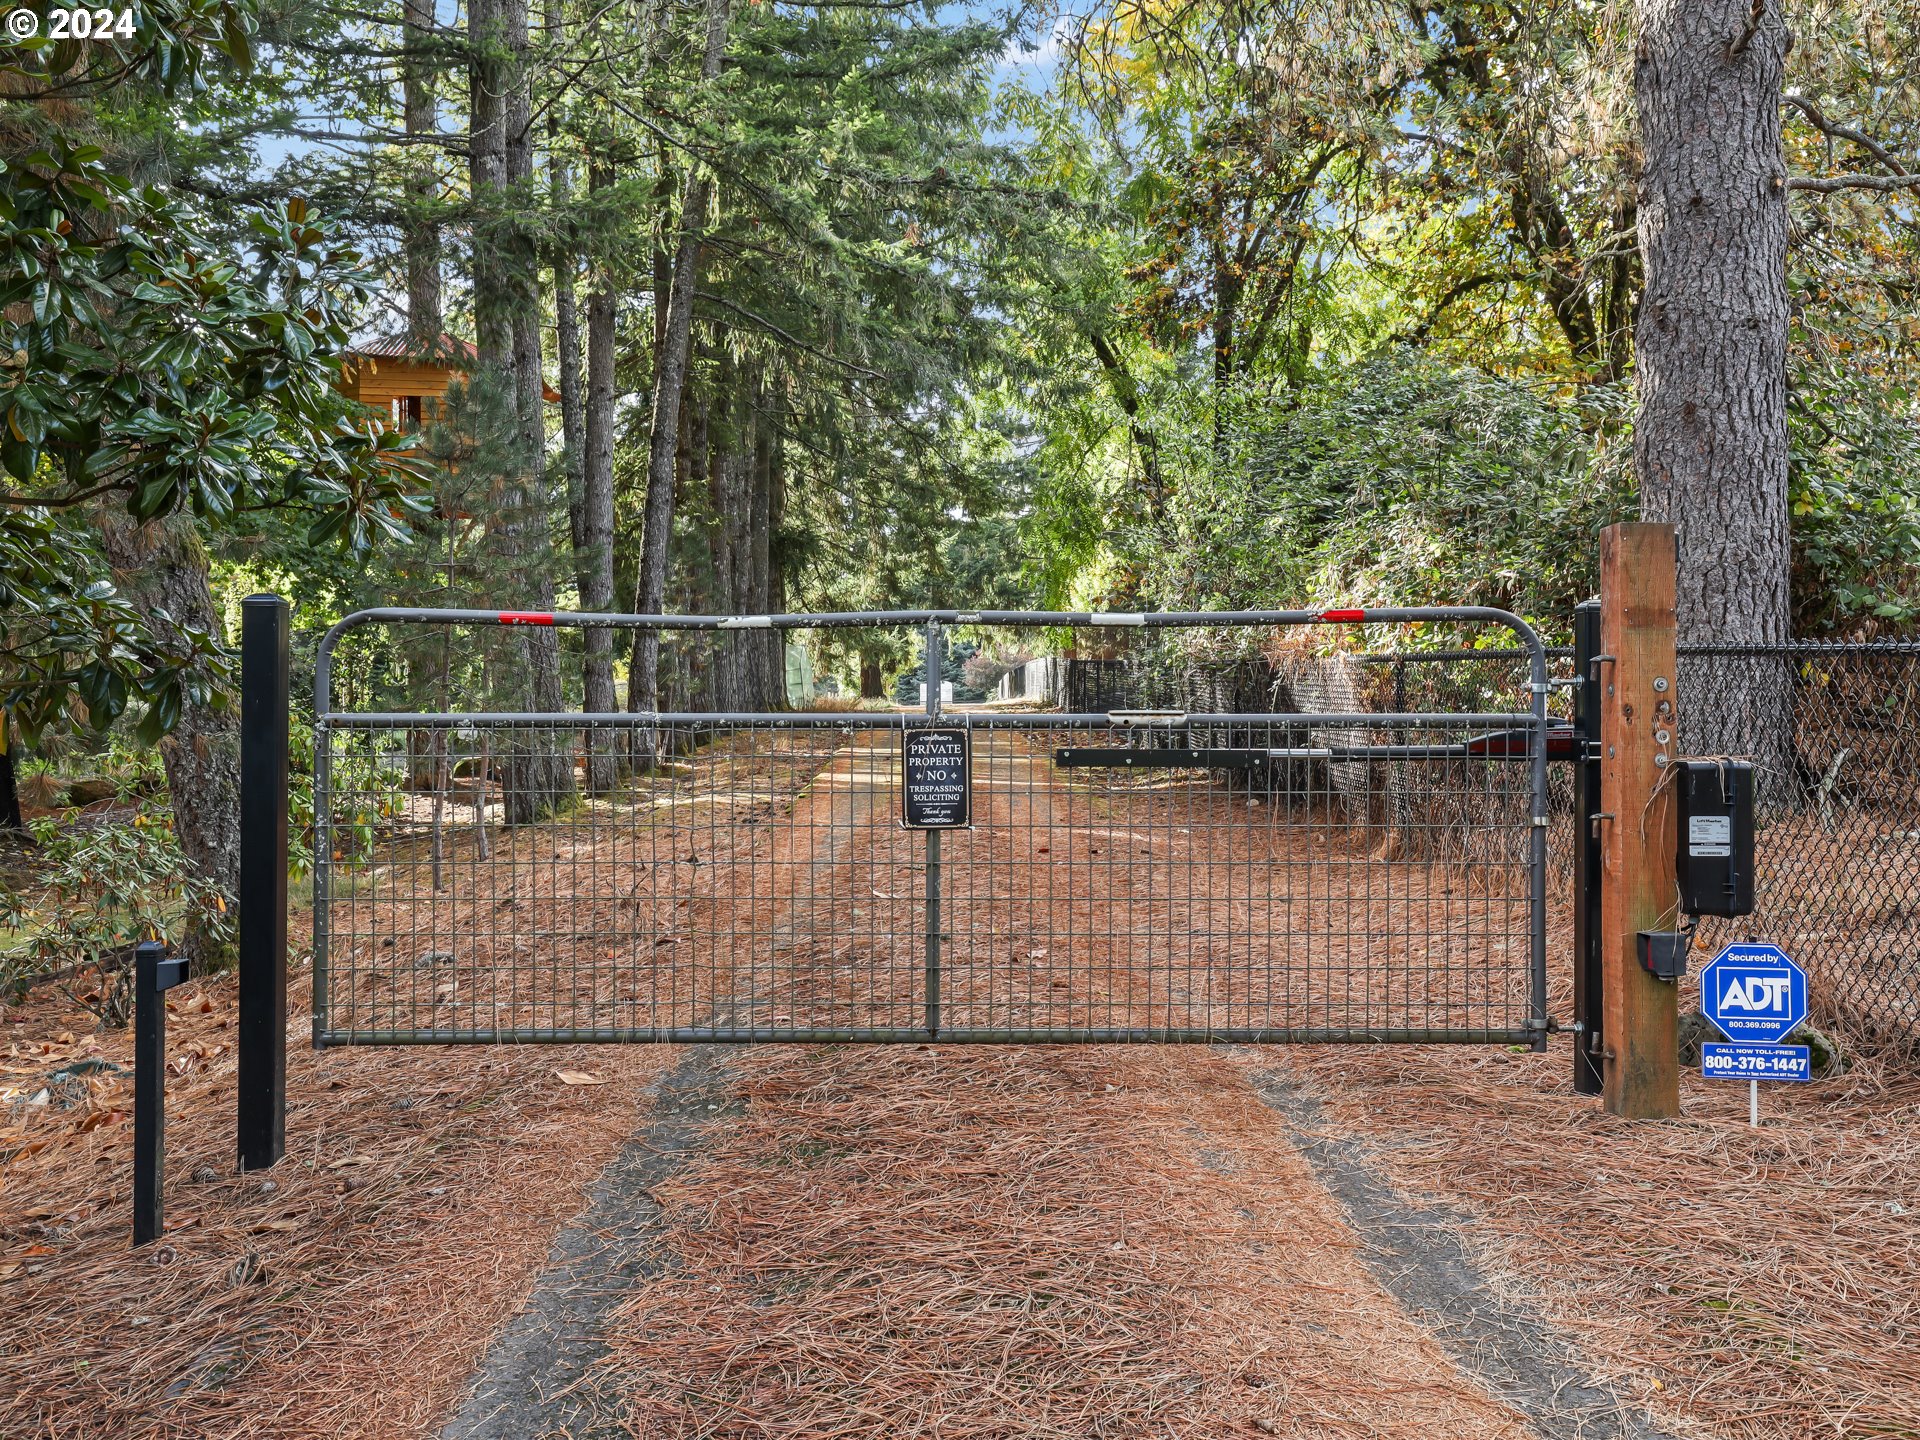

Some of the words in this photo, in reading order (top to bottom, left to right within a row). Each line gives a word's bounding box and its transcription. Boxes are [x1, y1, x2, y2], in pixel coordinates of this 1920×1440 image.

[911, 744, 962, 755] PRIVATE
[909, 757, 963, 767] PROPERTY
[926, 770, 947, 781] NO
[909, 785, 964, 793] TRESPASSING
[913, 794, 960, 802] SOLICITING
[922, 807, 940, 815] Thank
[940, 809, 951, 817] you
[1727, 953, 1767, 962] Secured
[1767, 954, 1779, 964] by
[1720, 976, 1788, 1012] ADT
[1728, 1021, 1781, 1029] 800.369.0996
[1705, 1055, 1807, 1071] 800-376-1447
